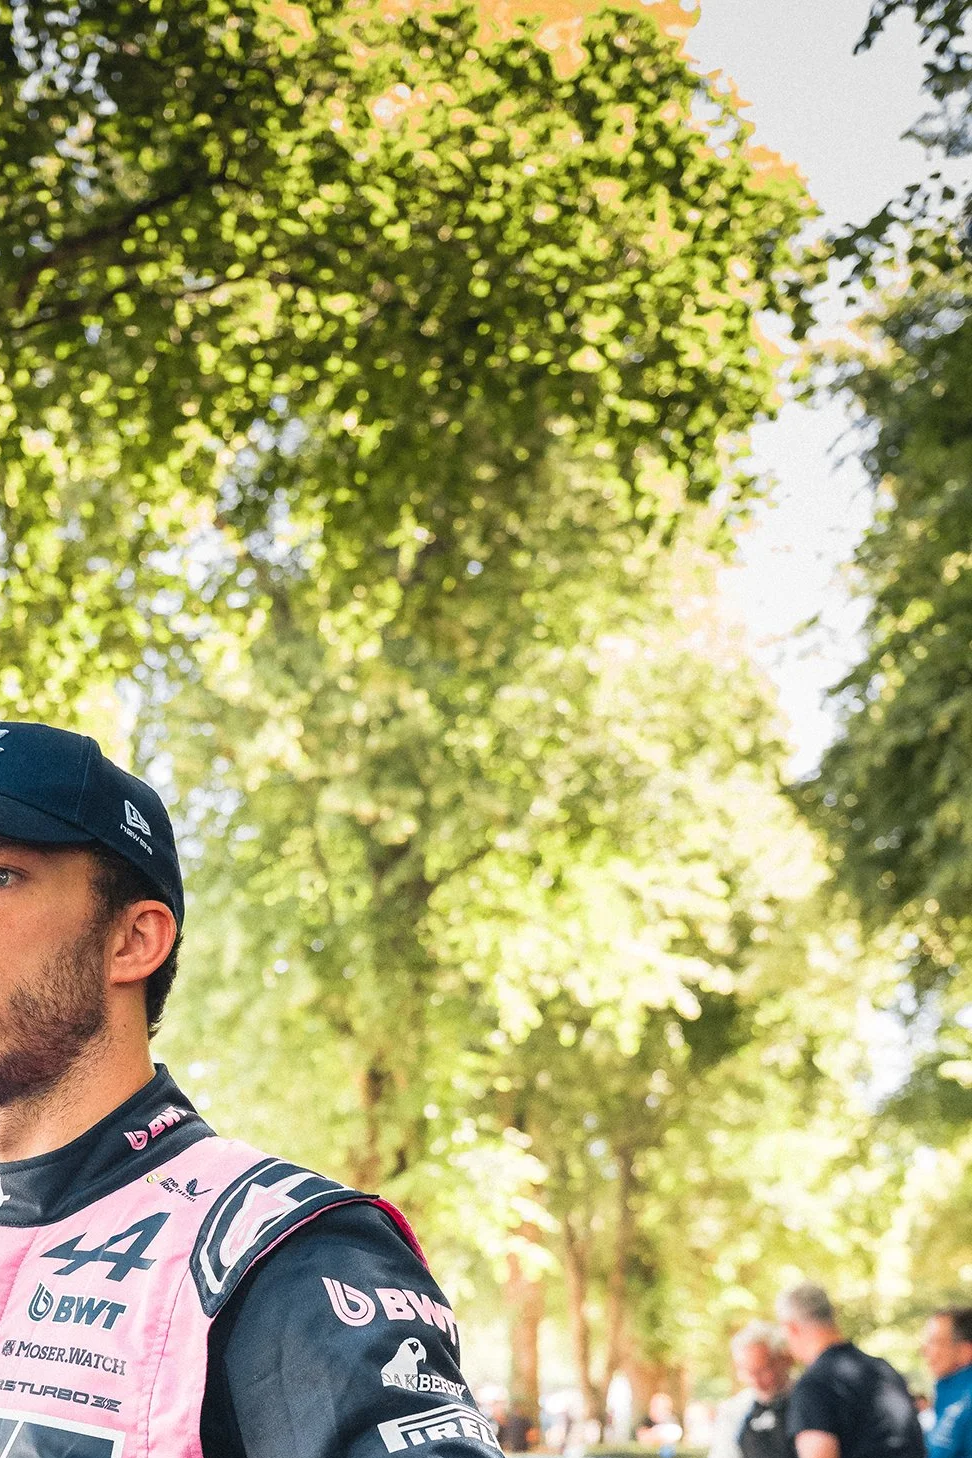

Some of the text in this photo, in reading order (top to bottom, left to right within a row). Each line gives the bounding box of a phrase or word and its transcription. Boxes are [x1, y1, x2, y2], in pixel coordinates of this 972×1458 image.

[52, 1295, 127, 1330] BWT
[375, 1288, 457, 1346] BWT
[15, 1341, 127, 1376] MOSER.WATCH
[381, 1373, 466, 1400] OAKBERRY
